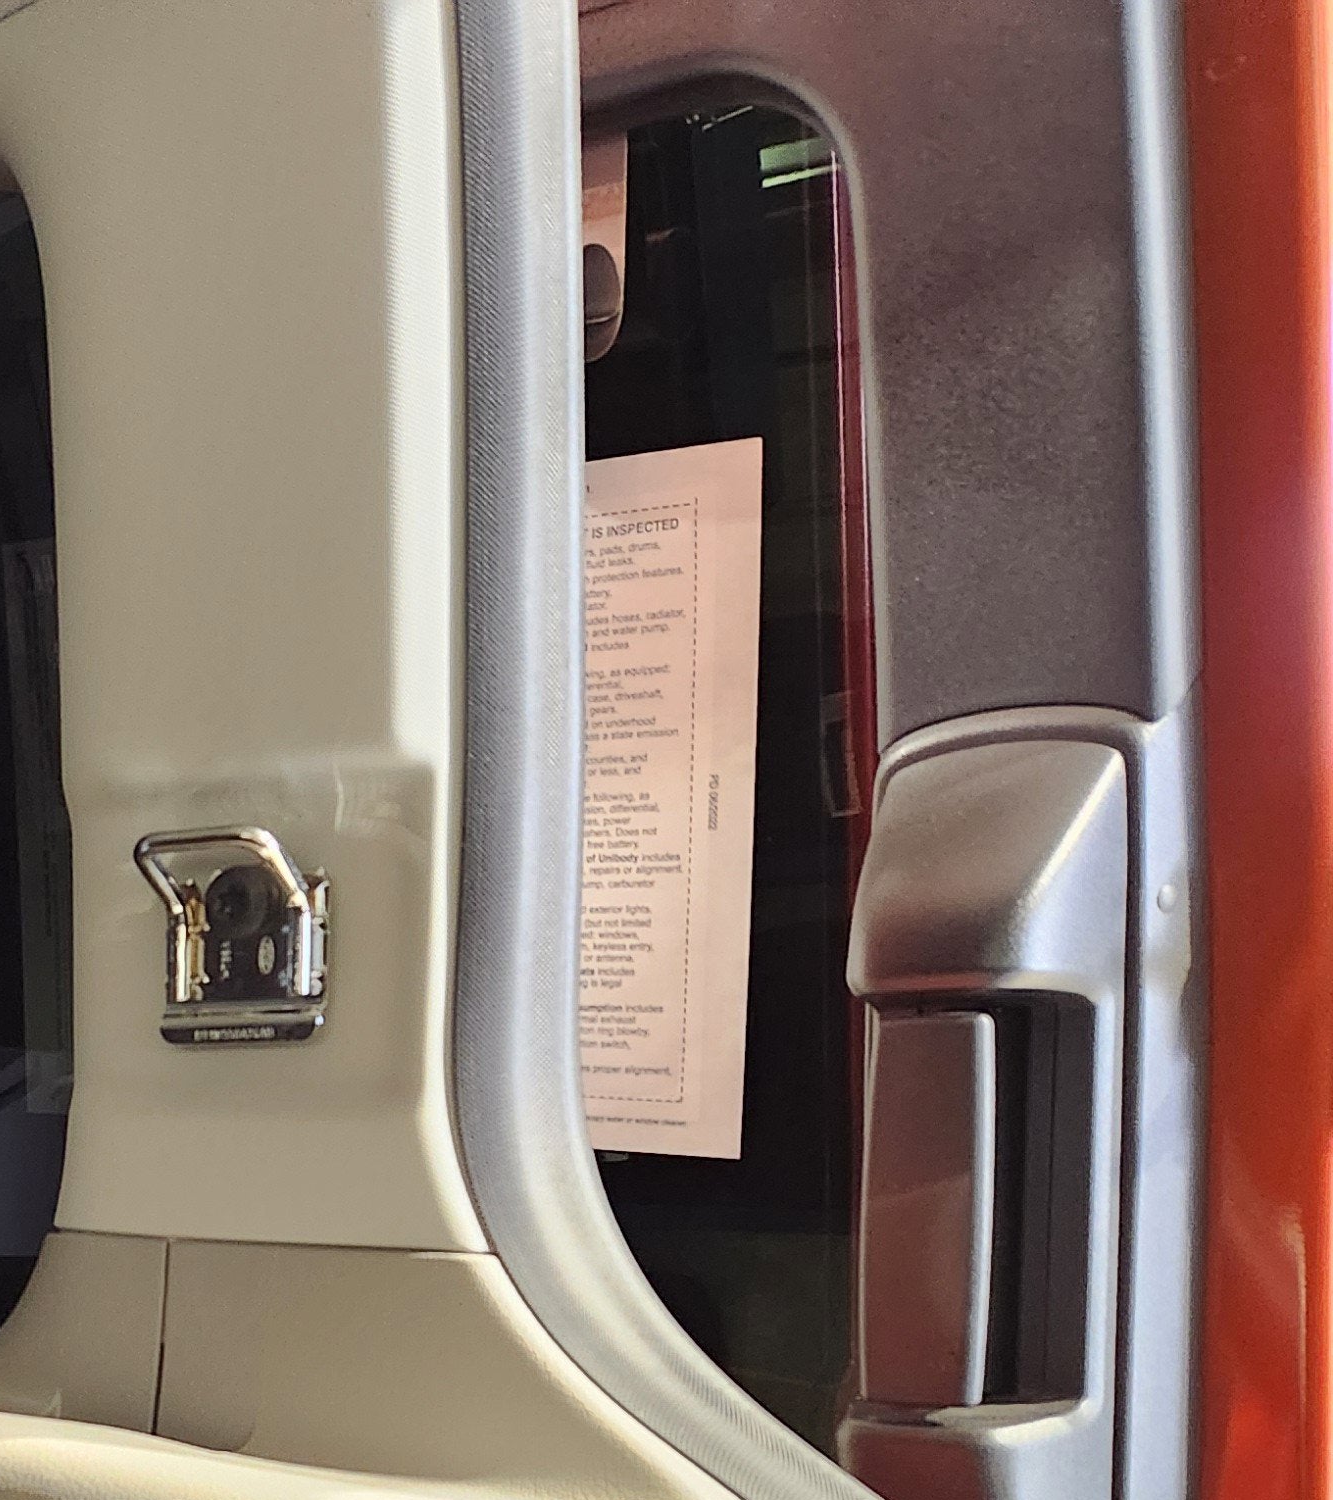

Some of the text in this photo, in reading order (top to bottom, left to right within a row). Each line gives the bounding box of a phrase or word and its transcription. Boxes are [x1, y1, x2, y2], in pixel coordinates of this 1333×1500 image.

[592, 518, 679, 539] IS INSPECTED
[593, 571, 639, 585] protection
[642, 827, 657, 835] not
[598, 853, 638, 863] Unibody
[642, 852, 681, 862] includes
[604, 919, 619, 927] not
